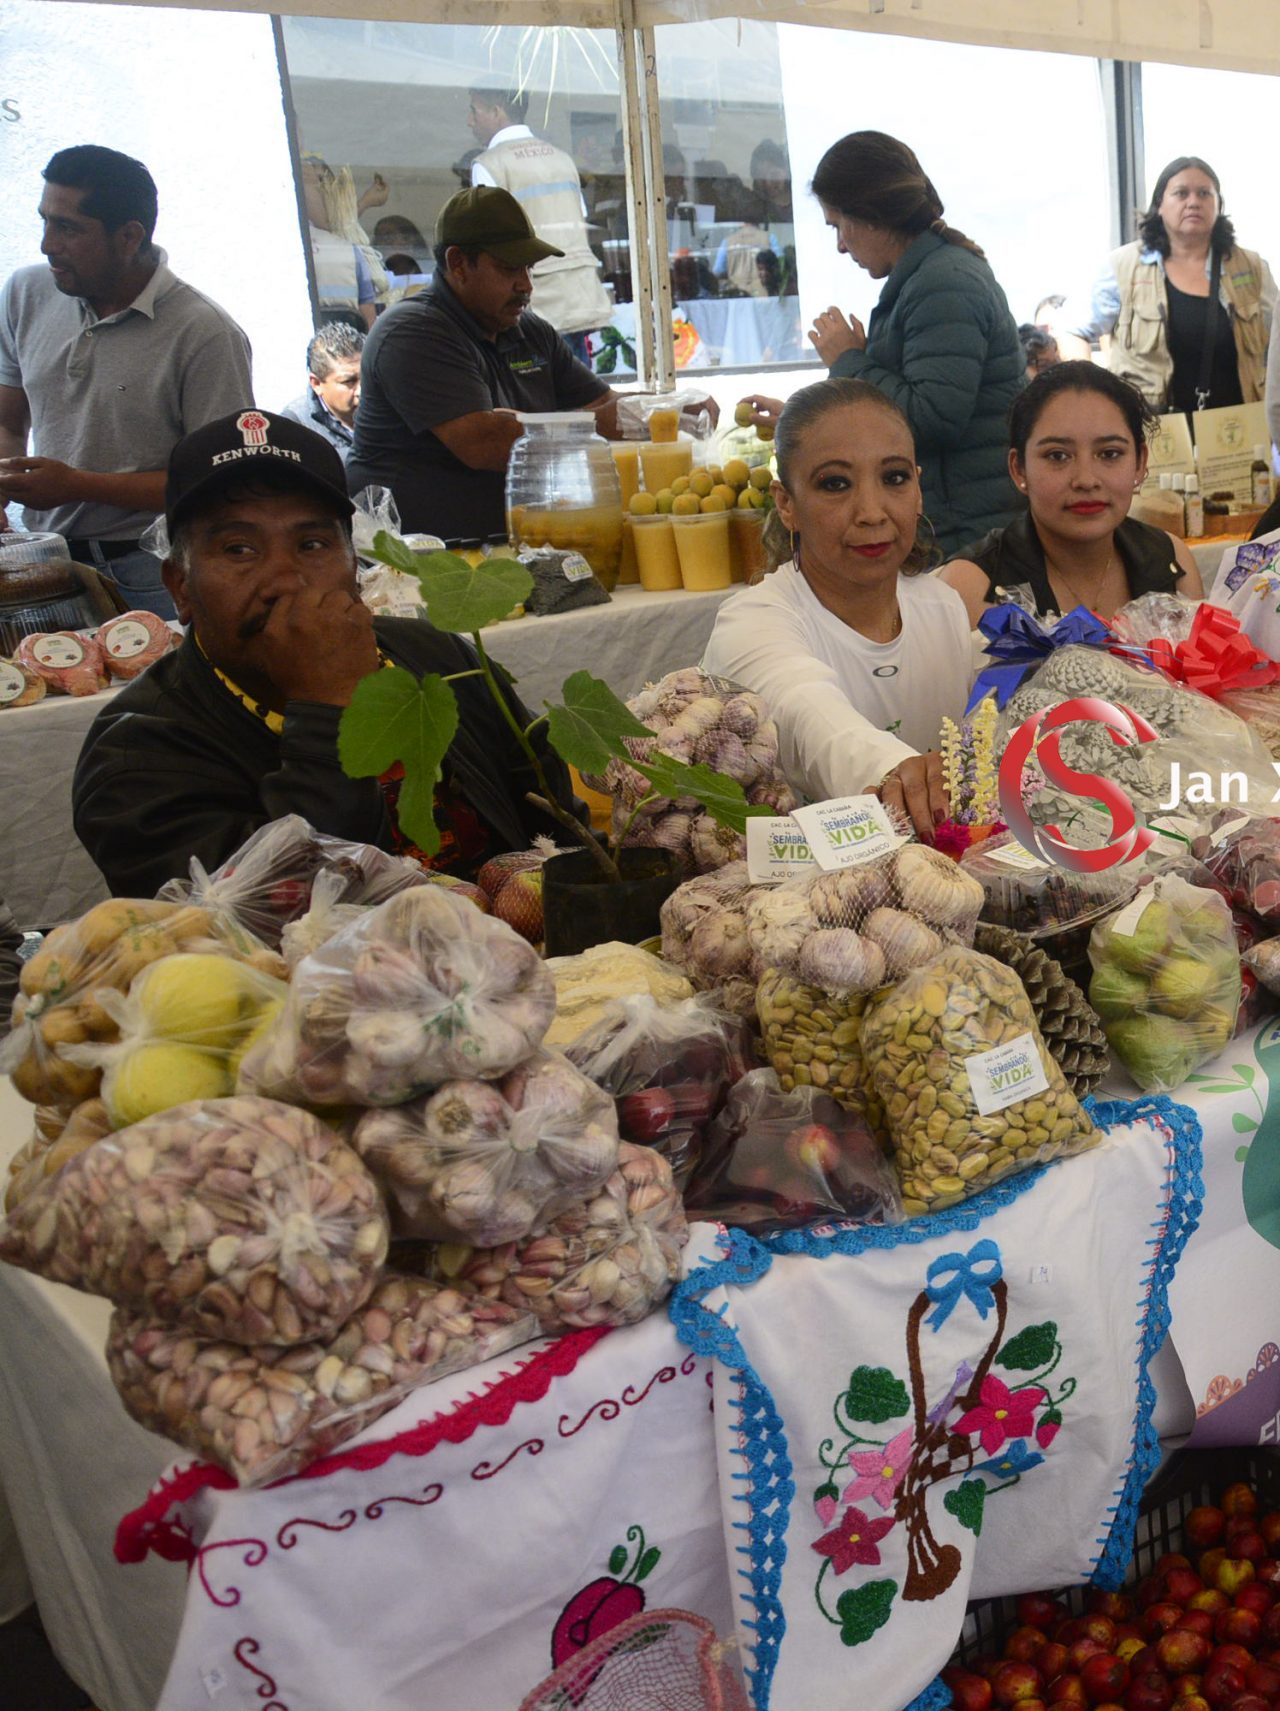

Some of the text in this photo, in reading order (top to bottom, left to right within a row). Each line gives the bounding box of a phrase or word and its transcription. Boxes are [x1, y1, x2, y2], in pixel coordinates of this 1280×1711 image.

[211, 445, 302, 467] KENWORTH
[772, 834, 809, 846] SEMBRA
[828, 819, 883, 846] VIDA
[840, 851, 854, 864] AJO
[991, 1064, 1033, 1090] VIDA
